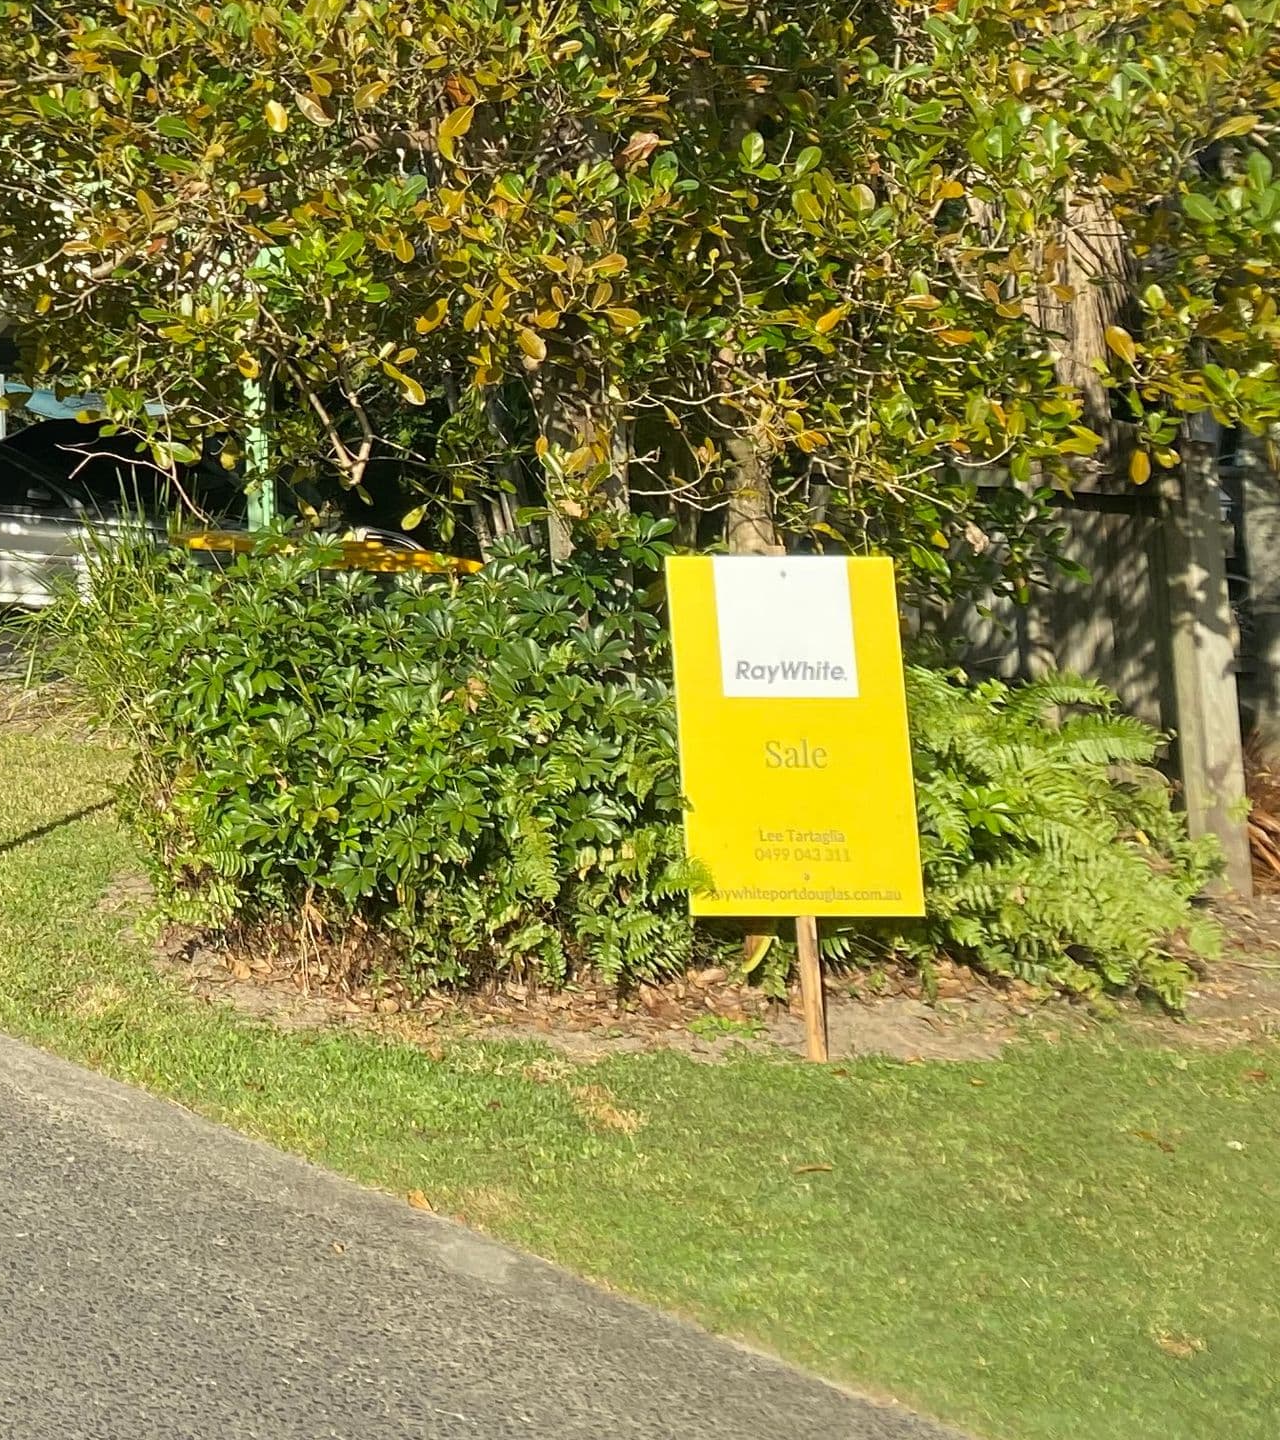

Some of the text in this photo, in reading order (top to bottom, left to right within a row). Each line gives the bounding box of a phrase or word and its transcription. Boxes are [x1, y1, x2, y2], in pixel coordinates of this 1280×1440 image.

[764, 738, 829, 770] Sale
[759, 828, 846, 845] Lee Tartaglia
[754, 847, 790, 862] 0499
[712, 886, 902, 902] aywhiteportdouglas.com.au
